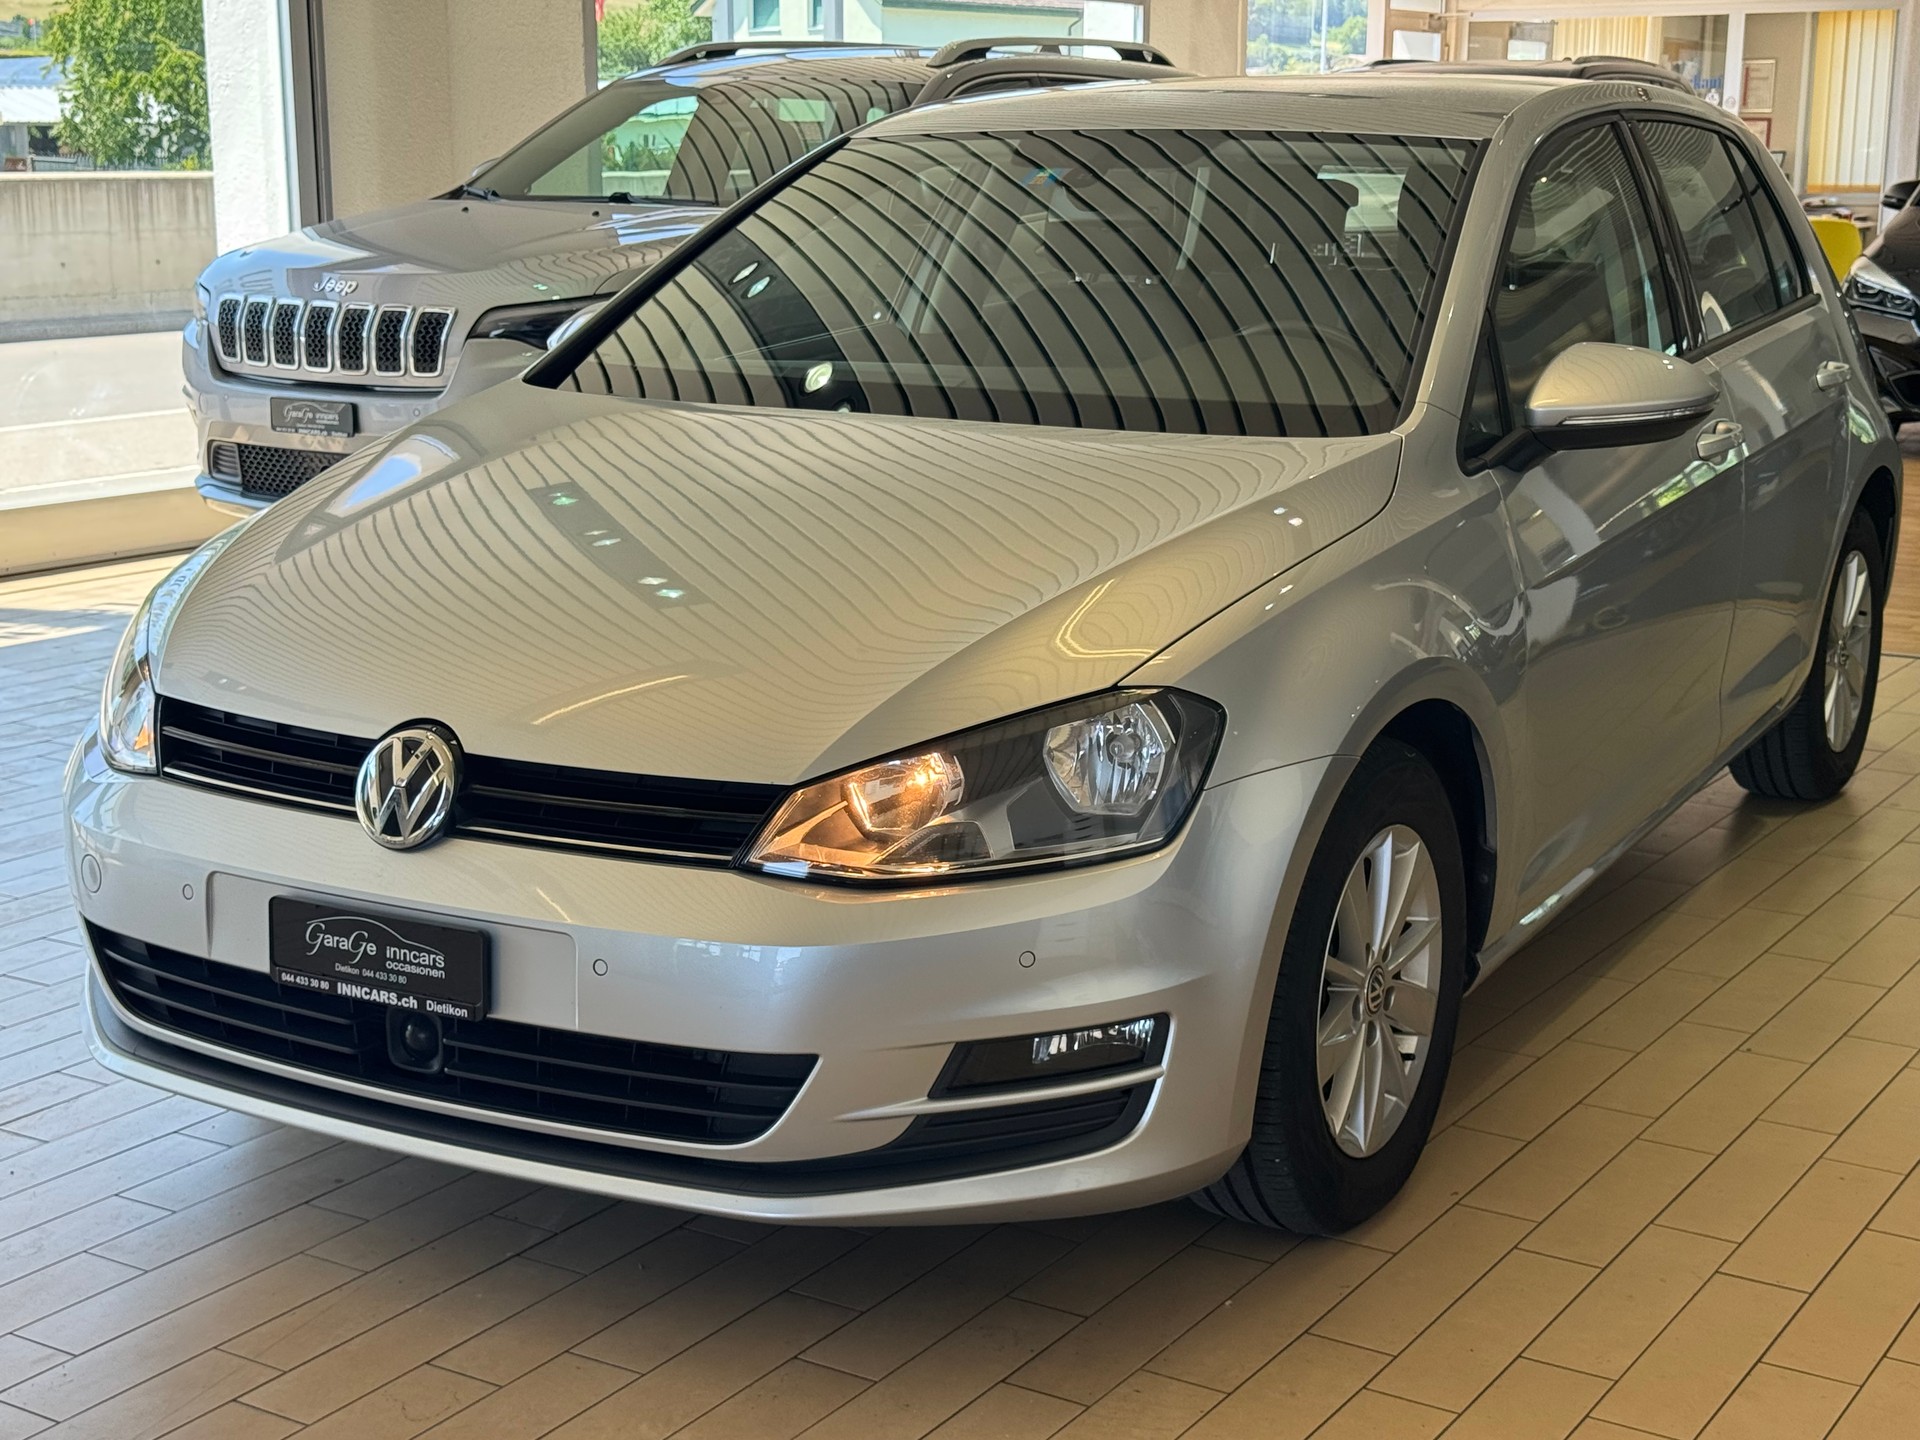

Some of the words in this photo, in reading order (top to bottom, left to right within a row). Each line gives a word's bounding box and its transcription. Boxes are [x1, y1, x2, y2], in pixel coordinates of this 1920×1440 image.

[312, 277, 359, 297] Jeep
[361, 732, 450, 844] VW
[305, 922, 377, 964] GaraGe
[386, 945, 445, 968] inncars
[334, 962, 360, 975] Dietikon
[362, 968, 374, 978] 044
[375, 971, 388, 981] 433
[388, 973, 397, 983] 30
[398, 975, 407, 985] 80
[385, 960, 445, 979] occasionen
[281, 972, 295, 983] 044
[295, 975, 309, 986] 433
[309, 978, 319, 988] 30
[320, 980, 330, 990] 80
[336, 981, 418, 1009] INNCARS.ch
[426, 999, 468, 1018] Dietikon
